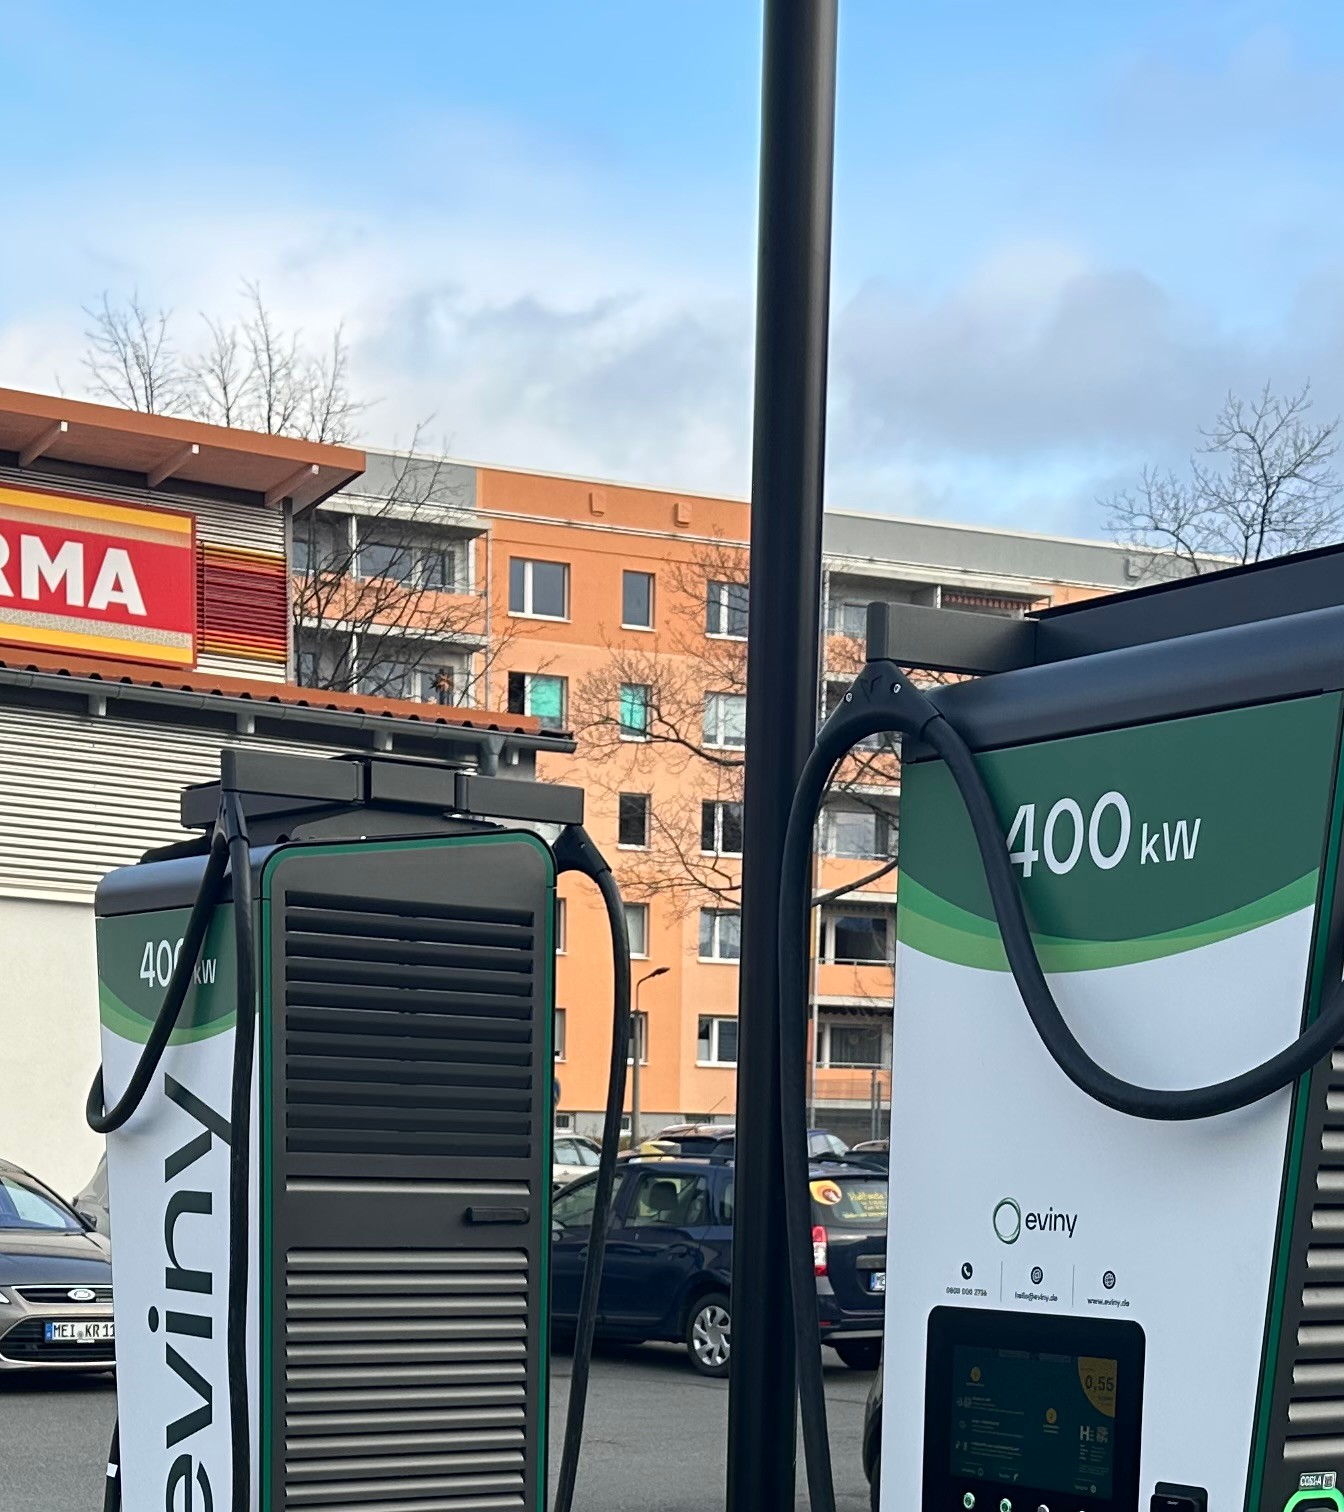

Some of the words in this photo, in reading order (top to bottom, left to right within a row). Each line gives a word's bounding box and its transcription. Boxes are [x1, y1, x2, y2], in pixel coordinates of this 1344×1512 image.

[1006, 790, 1131, 878] 400
[1140, 818, 1202, 865] kW
[1025, 1206, 1078, 1239] eviny
[1086, 1297, 1130, 1308] www.eviny.de
[53, 1324, 75, 1338] MEI
[85, 1324, 100, 1338] KR
